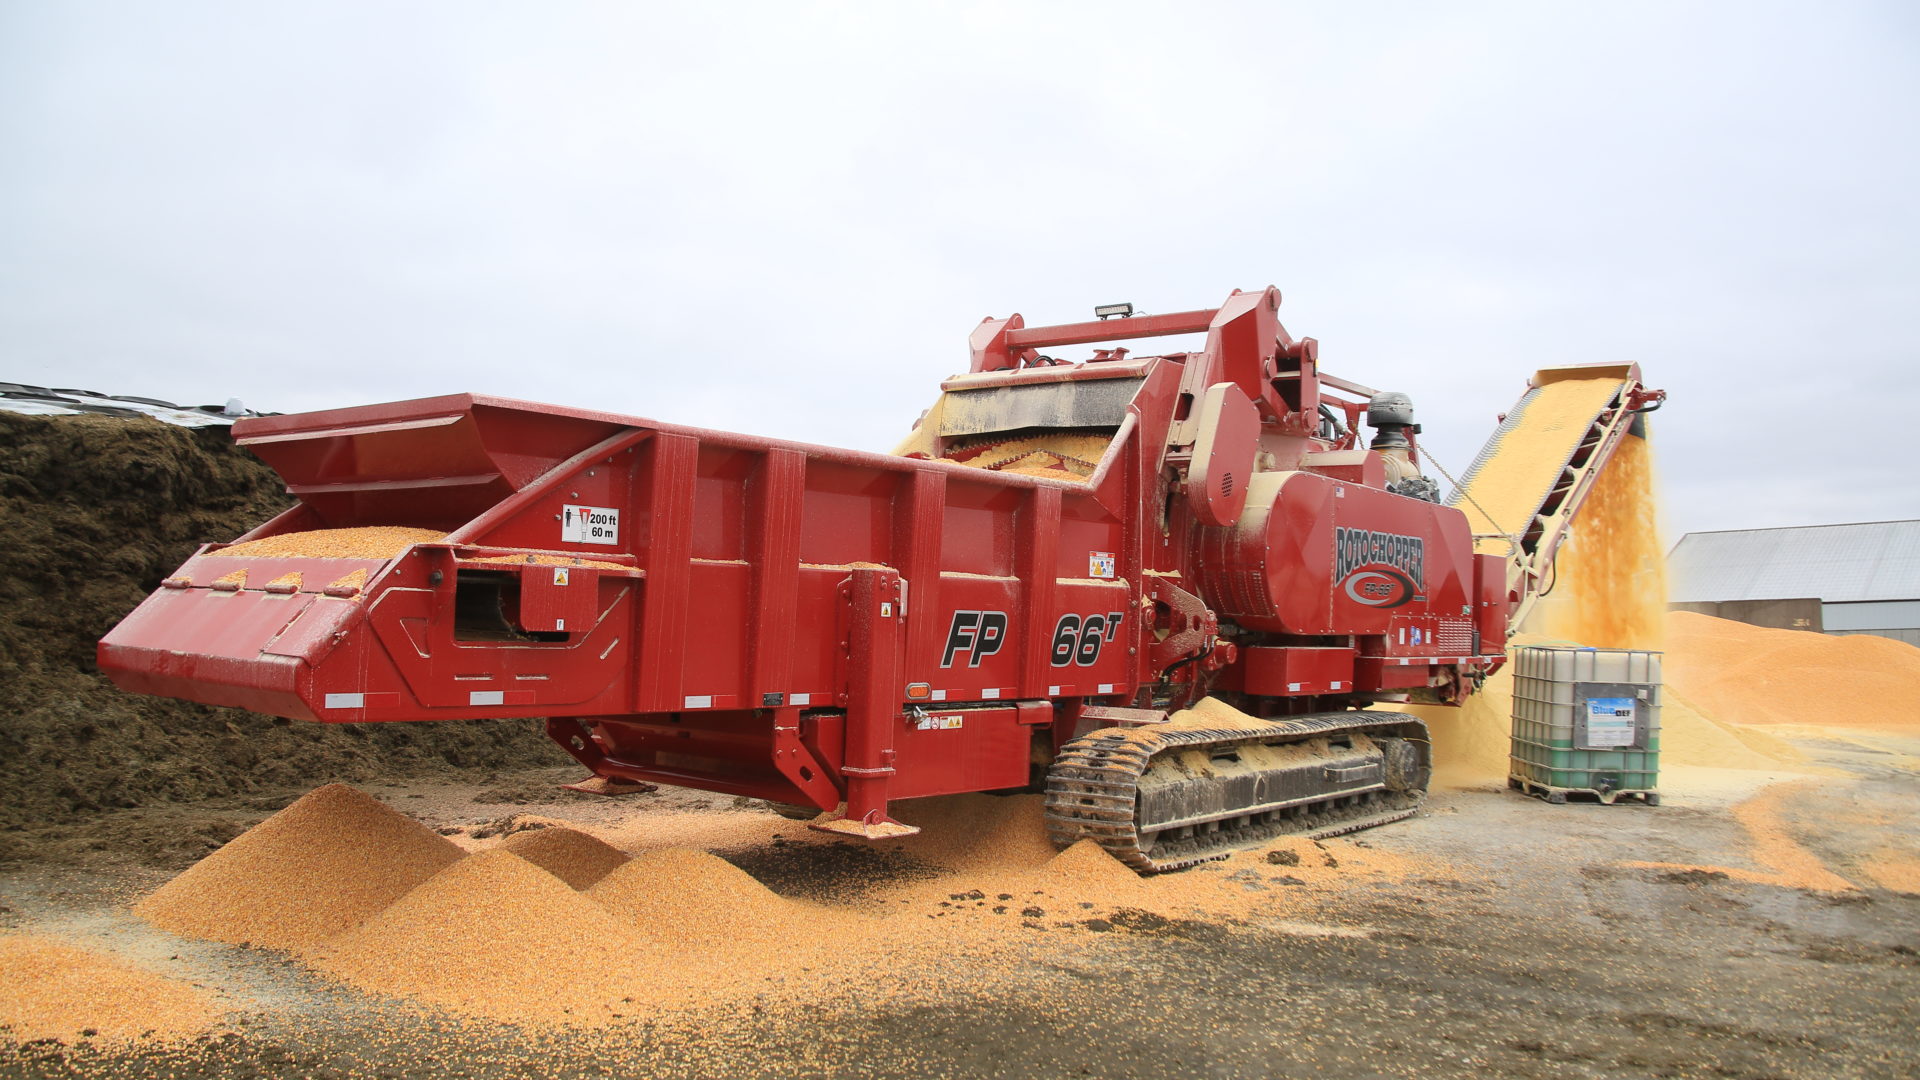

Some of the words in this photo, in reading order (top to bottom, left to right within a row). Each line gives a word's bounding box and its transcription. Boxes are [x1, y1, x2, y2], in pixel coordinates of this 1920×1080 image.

[590, 513, 607, 525] 200
[609, 515, 616, 525] ft
[592, 527, 603, 537] 60
[605, 530, 613, 538] m
[1335, 526, 1424, 593] ROTOCHOPPER
[940, 610, 1007, 668] FP
